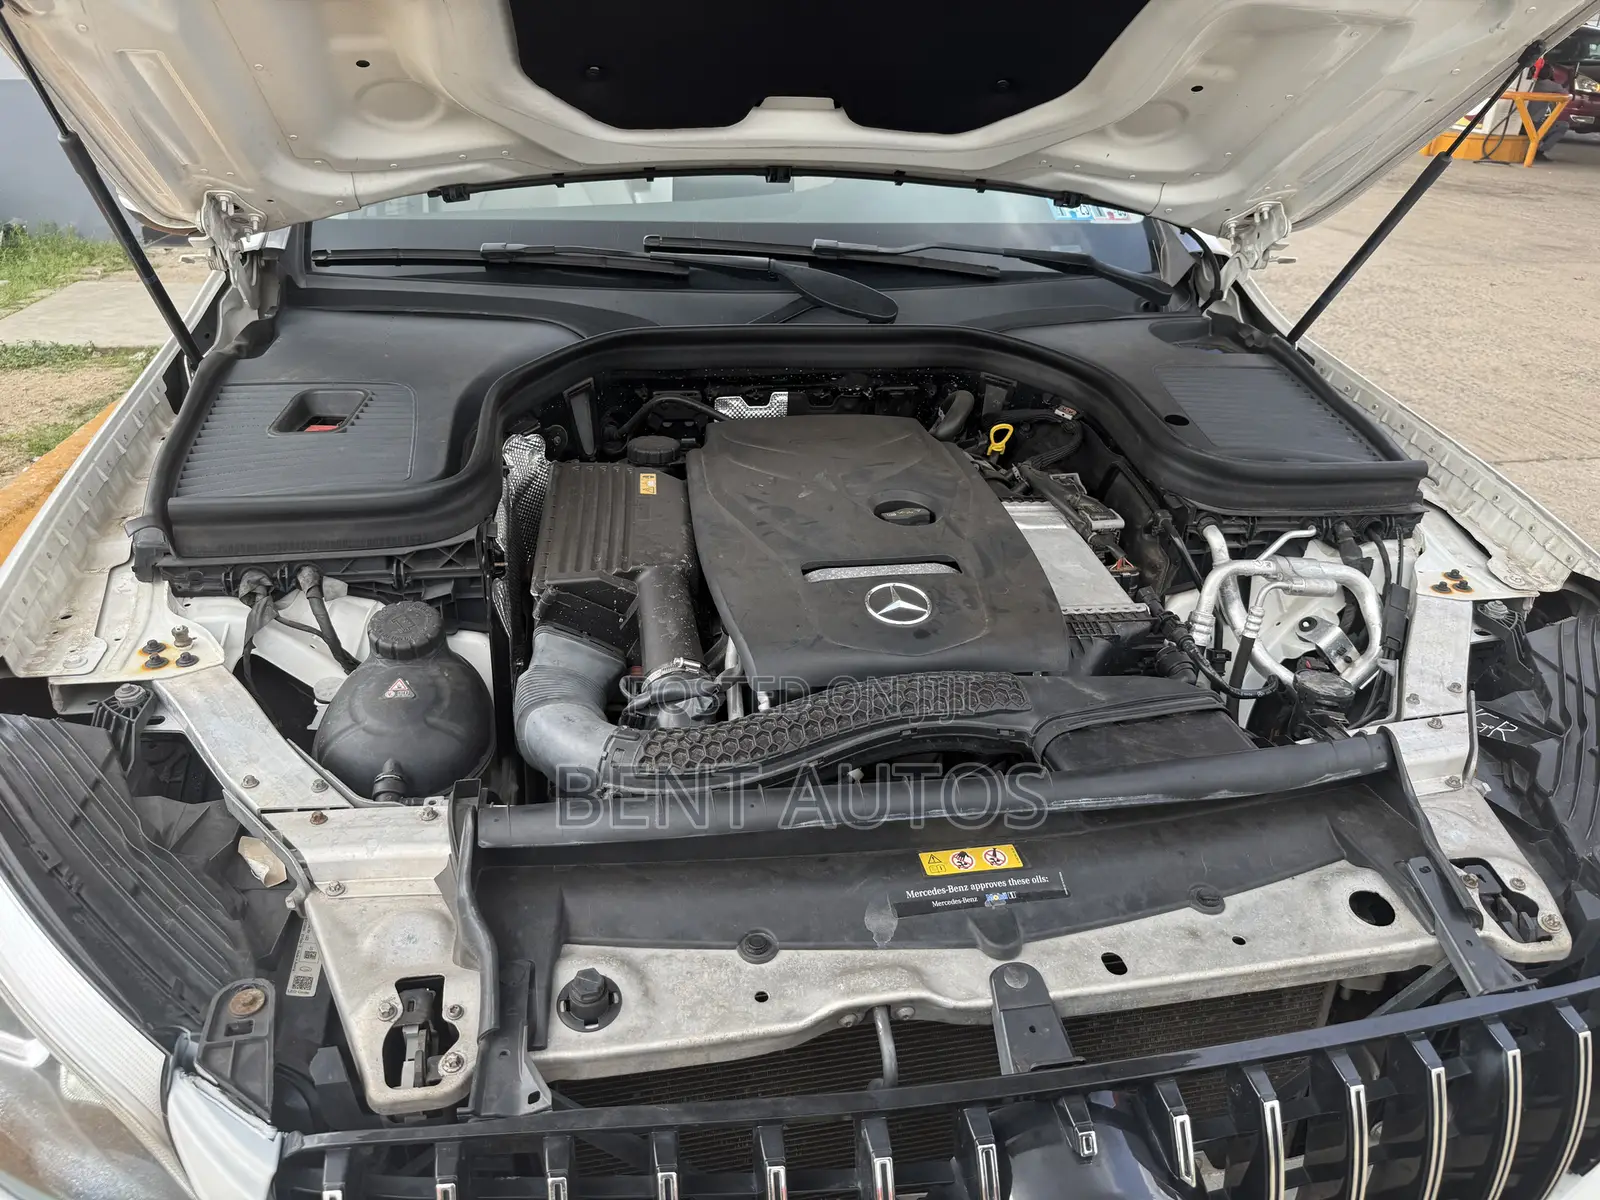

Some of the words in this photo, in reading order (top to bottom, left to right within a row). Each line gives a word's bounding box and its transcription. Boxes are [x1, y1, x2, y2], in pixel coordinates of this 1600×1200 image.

[905, 884, 969, 899] Mercedes-Benz
[970, 879, 1007, 892] approves
[1008, 876, 1031, 887] these
[1032, 874, 1050, 885] oils:
[931, 896, 978, 908] Mercedes-Benz
